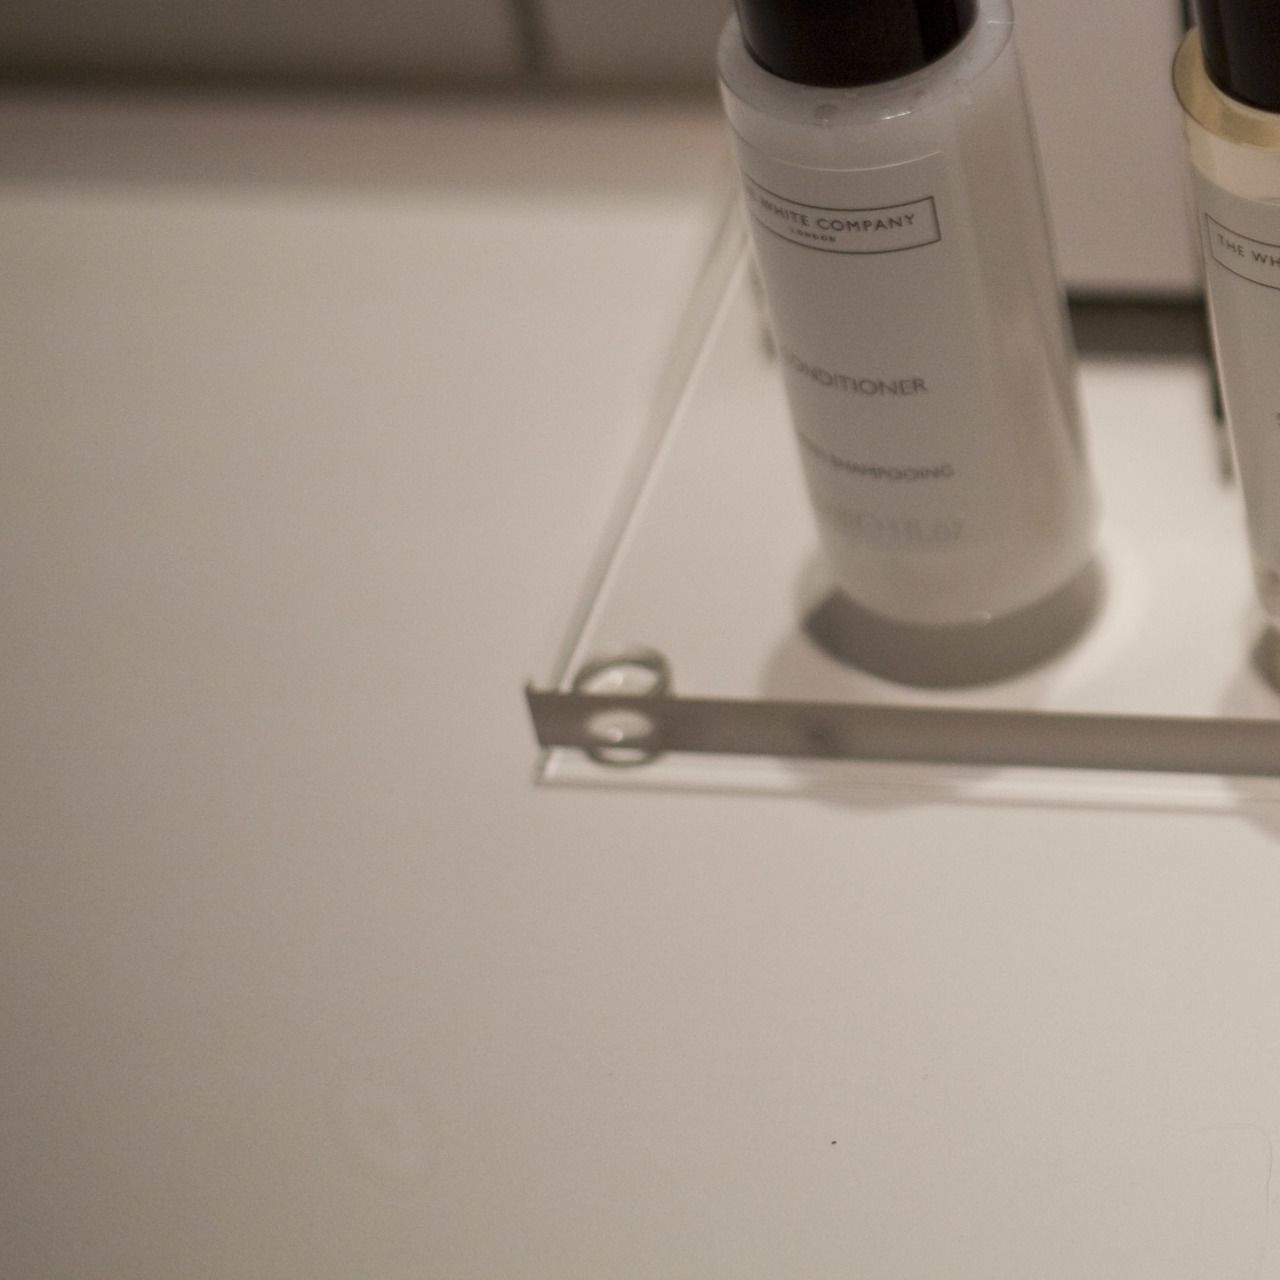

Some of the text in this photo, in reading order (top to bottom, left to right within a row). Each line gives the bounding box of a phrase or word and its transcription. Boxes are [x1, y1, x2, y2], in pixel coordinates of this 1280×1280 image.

[759, 195, 916, 233] WHITE COMPANY
[789, 227, 838, 243] LONDON
[1216, 233, 1245, 258] THE
[782, 350, 930, 396] ONDITIONER
